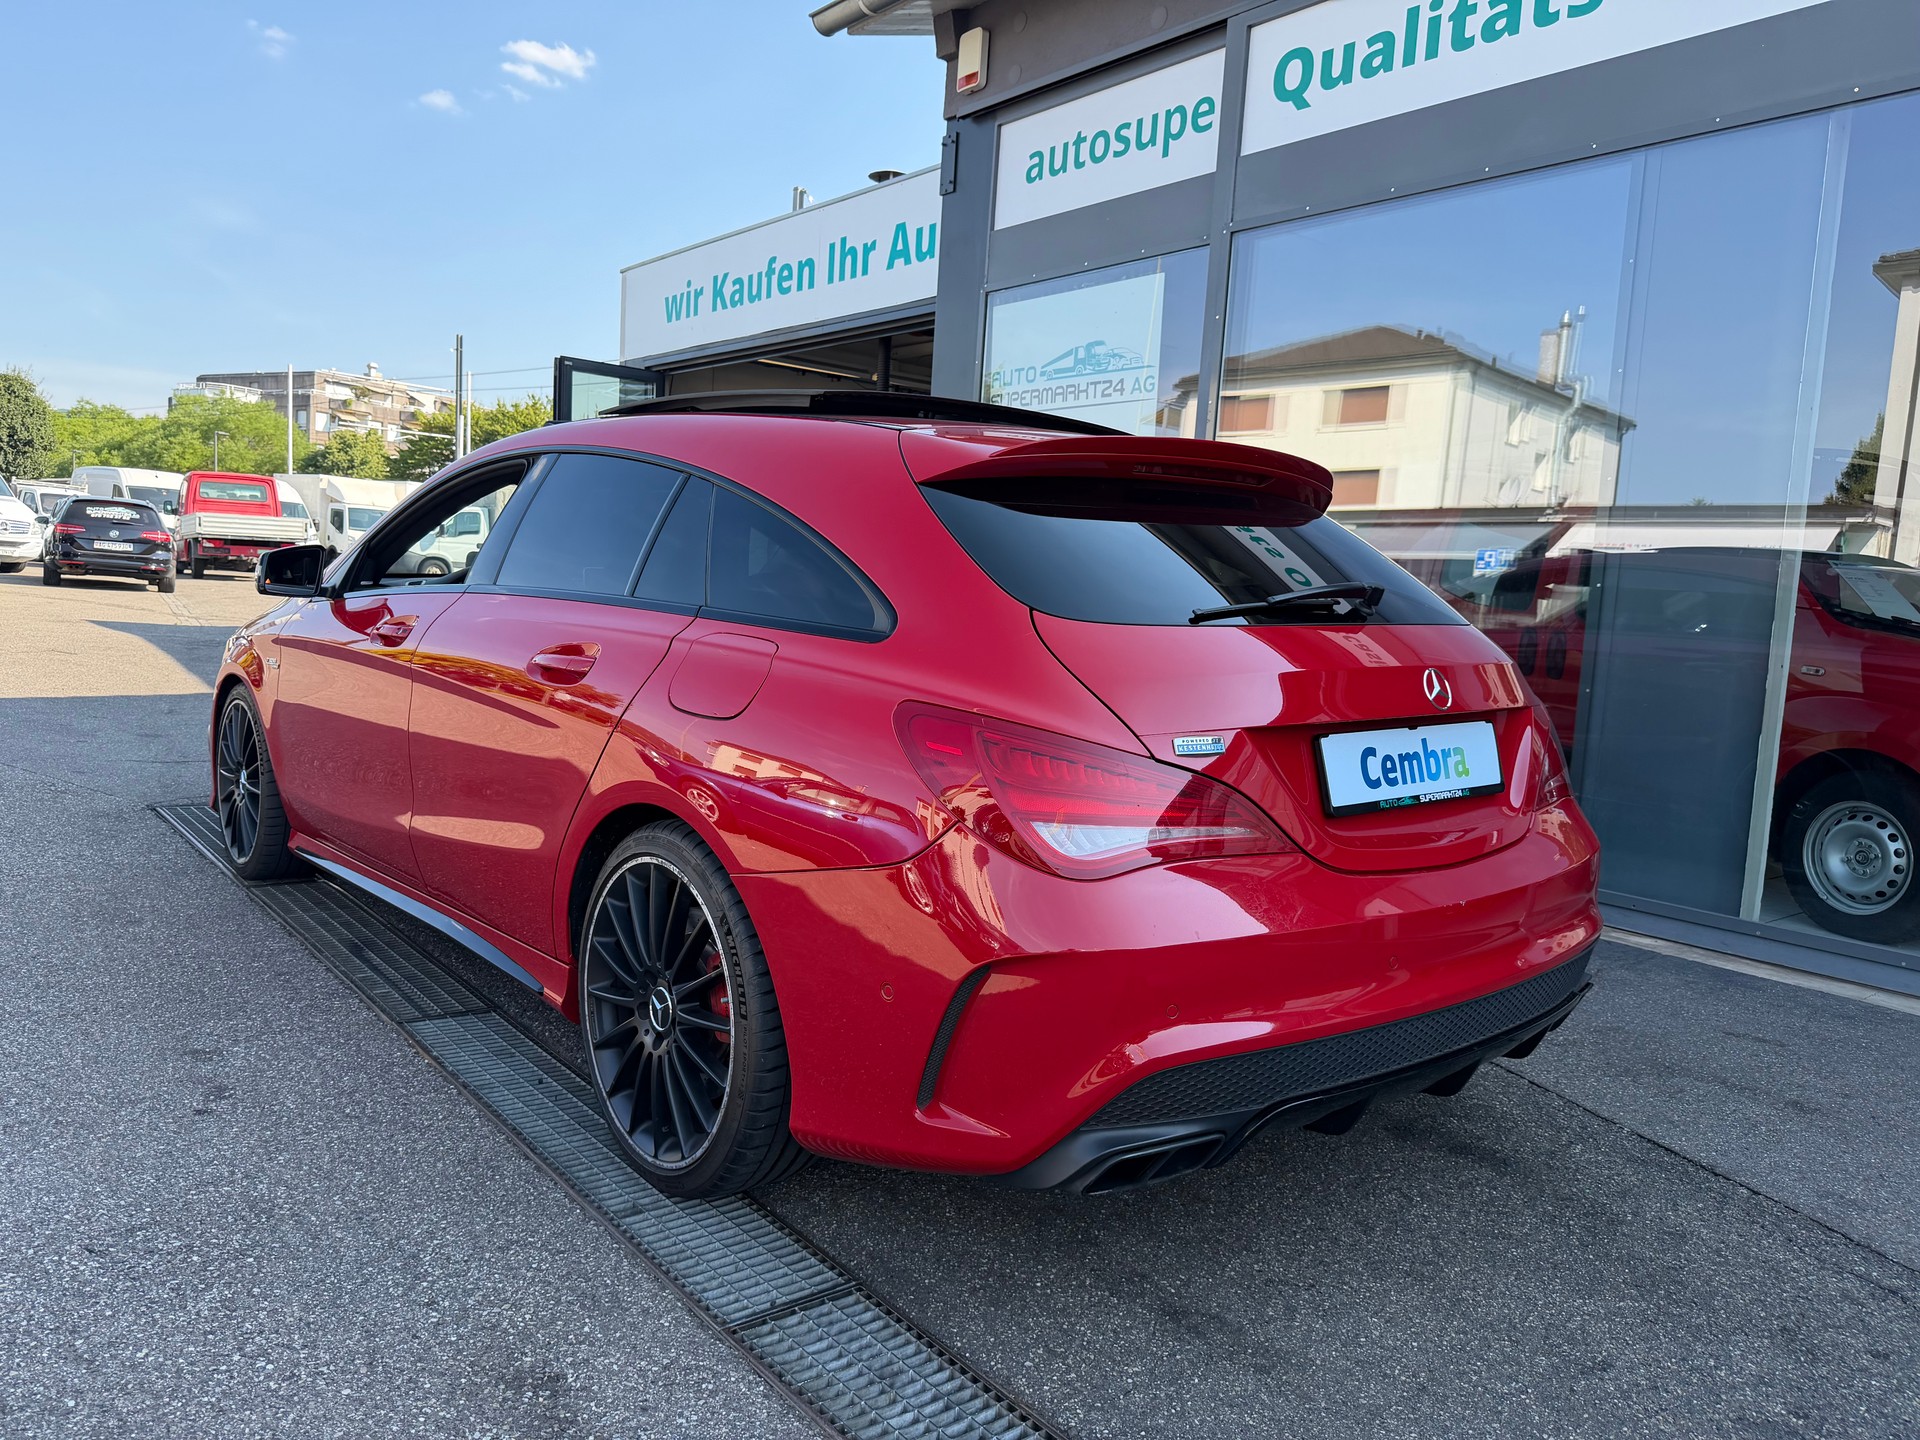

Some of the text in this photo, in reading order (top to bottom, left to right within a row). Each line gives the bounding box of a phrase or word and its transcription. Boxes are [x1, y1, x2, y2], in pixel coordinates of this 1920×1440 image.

[1025, 96, 1216, 184] autosupe
[664, 279, 704, 324] wir
[711, 255, 816, 313] Kaufen
[827, 235, 878, 286] Ihr
[990, 375, 1156, 408] SUPERMARKT24 AG
[991, 366, 1037, 389] AUTO
[1360, 737, 1470, 790] Cembra
[1380, 799, 1398, 809] AUTO
[726, 935, 747, 1016] MICHELIN
